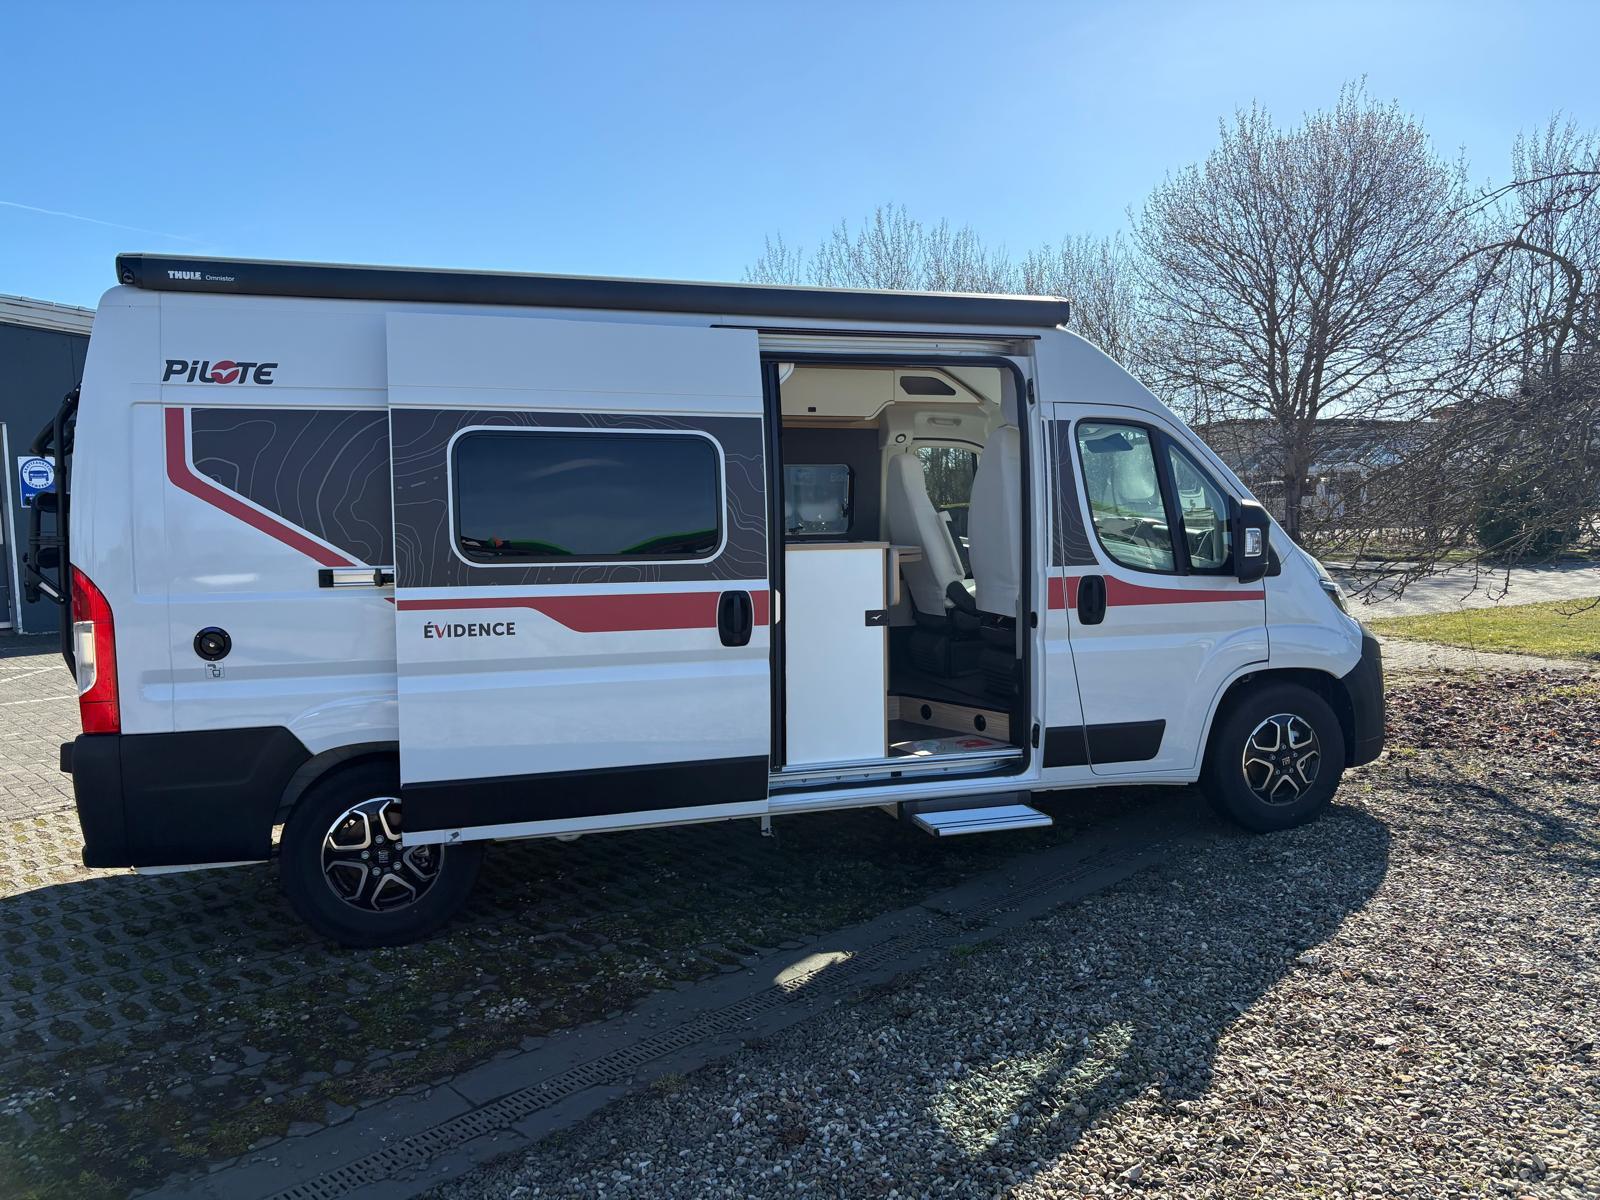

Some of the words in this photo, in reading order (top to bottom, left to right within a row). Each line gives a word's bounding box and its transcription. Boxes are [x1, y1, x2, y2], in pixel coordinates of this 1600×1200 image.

[168, 270, 201, 280] THULE
[205, 274, 235, 282] Omnistor
[423, 621, 516, 639] ÉVIDENCE
